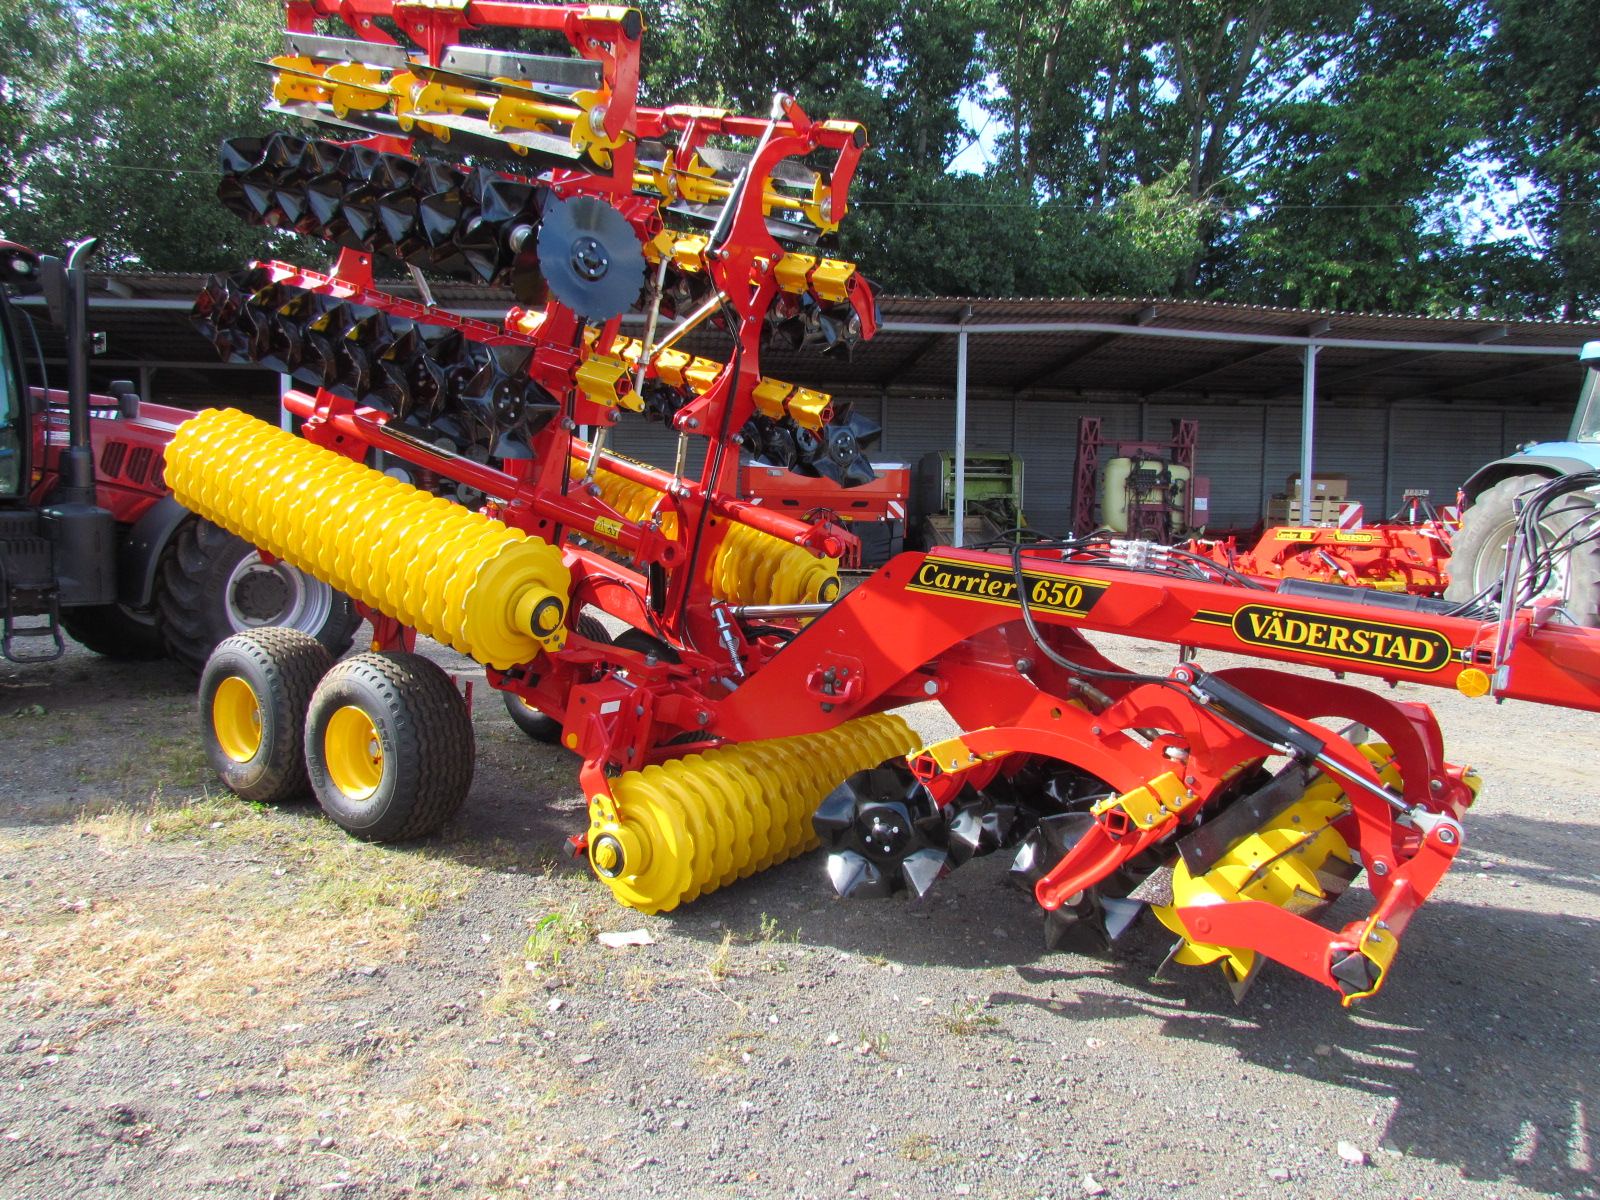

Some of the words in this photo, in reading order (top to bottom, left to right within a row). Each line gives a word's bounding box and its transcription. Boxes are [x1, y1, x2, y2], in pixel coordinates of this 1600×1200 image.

[919, 564, 1018, 597] Carrier
[1032, 580, 1083, 608] 650
[1249, 611, 1435, 663] VÄDERSTAD
